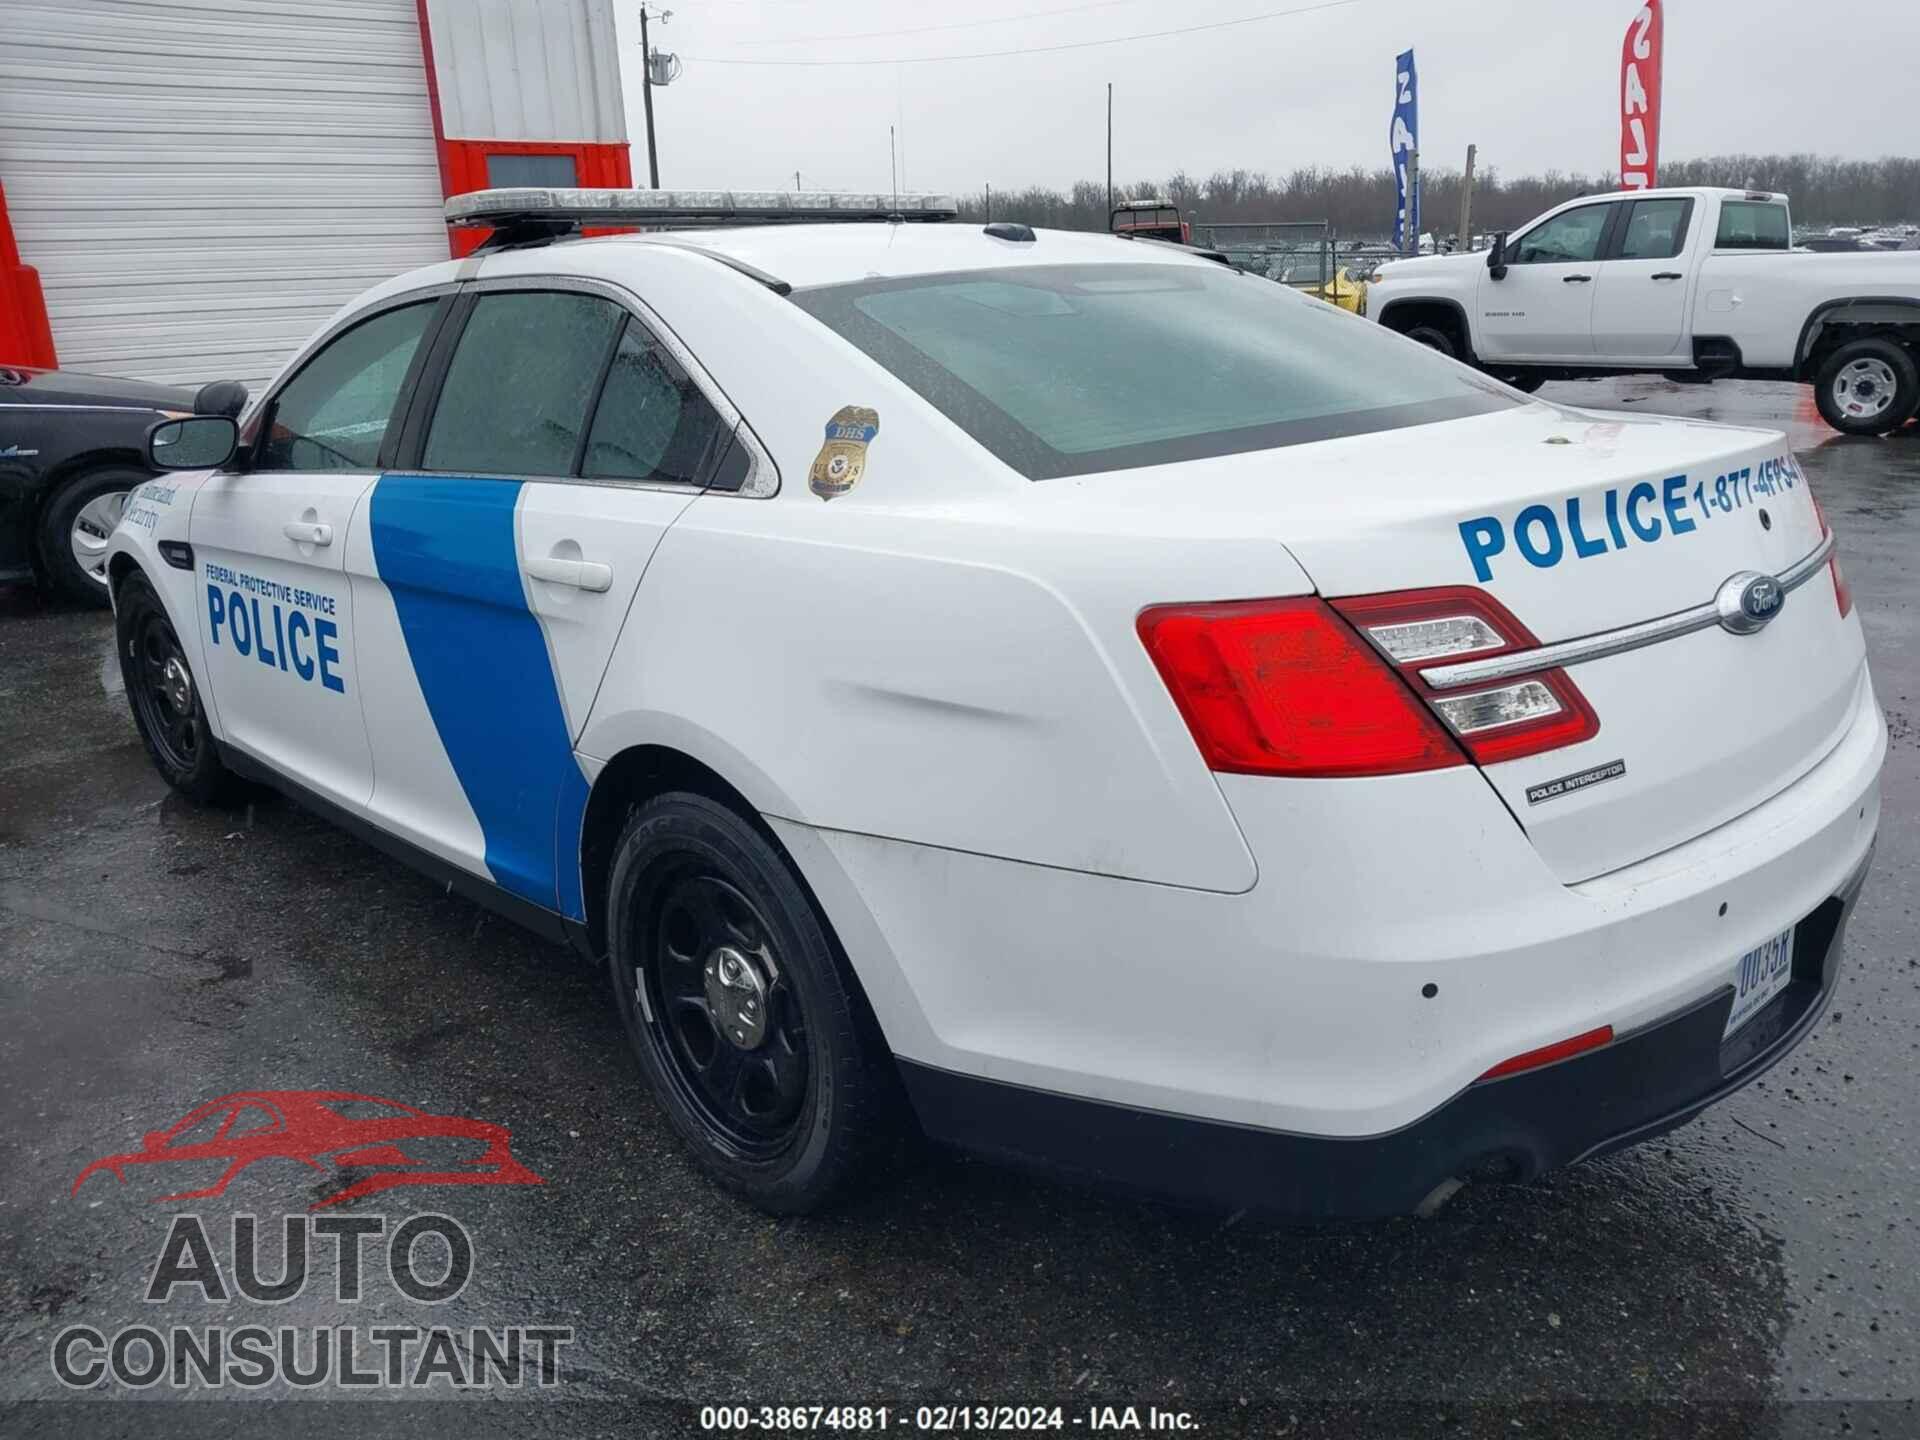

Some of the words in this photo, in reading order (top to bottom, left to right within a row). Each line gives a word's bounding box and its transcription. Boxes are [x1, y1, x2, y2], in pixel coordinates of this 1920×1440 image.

[836, 427, 865, 439] DHS
[1458, 475, 1696, 583] POLICE
[206, 563, 238, 587] FEDERAL
[240, 573, 292, 603] PROTECTIVE
[294, 589, 335, 616] SERVICE
[1753, 583, 1779, 613] Ford
[207, 584, 345, 694] POLICE
[1530, 783, 1564, 801] POLICE
[1565, 763, 1624, 790] INTERCEPTOR
